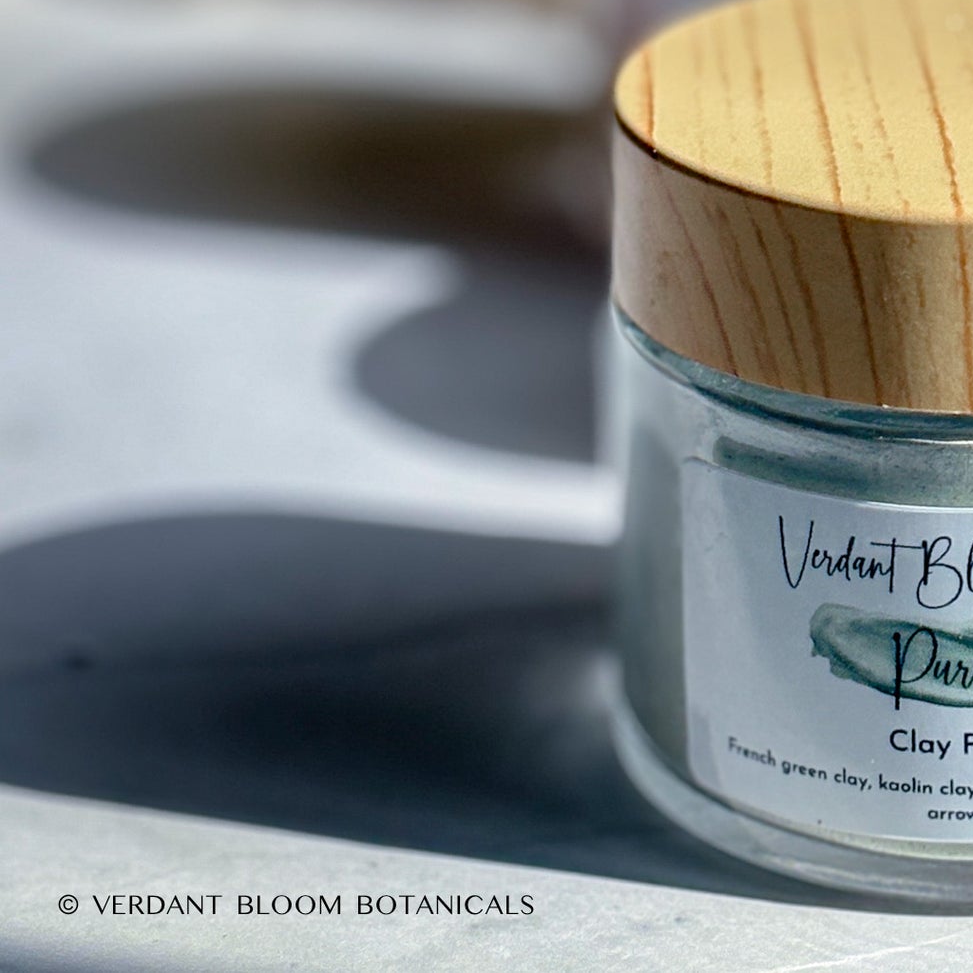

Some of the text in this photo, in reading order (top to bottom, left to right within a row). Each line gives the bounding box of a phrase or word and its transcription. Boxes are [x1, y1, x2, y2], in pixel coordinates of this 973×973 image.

[778, 514, 922, 593] Verdant
[727, 736, 777, 768] French
[781, 758, 828, 781] green
[833, 768, 873, 791] clay,
[878, 773, 933, 796] kaolin
[889, 728, 951, 760] Clay
